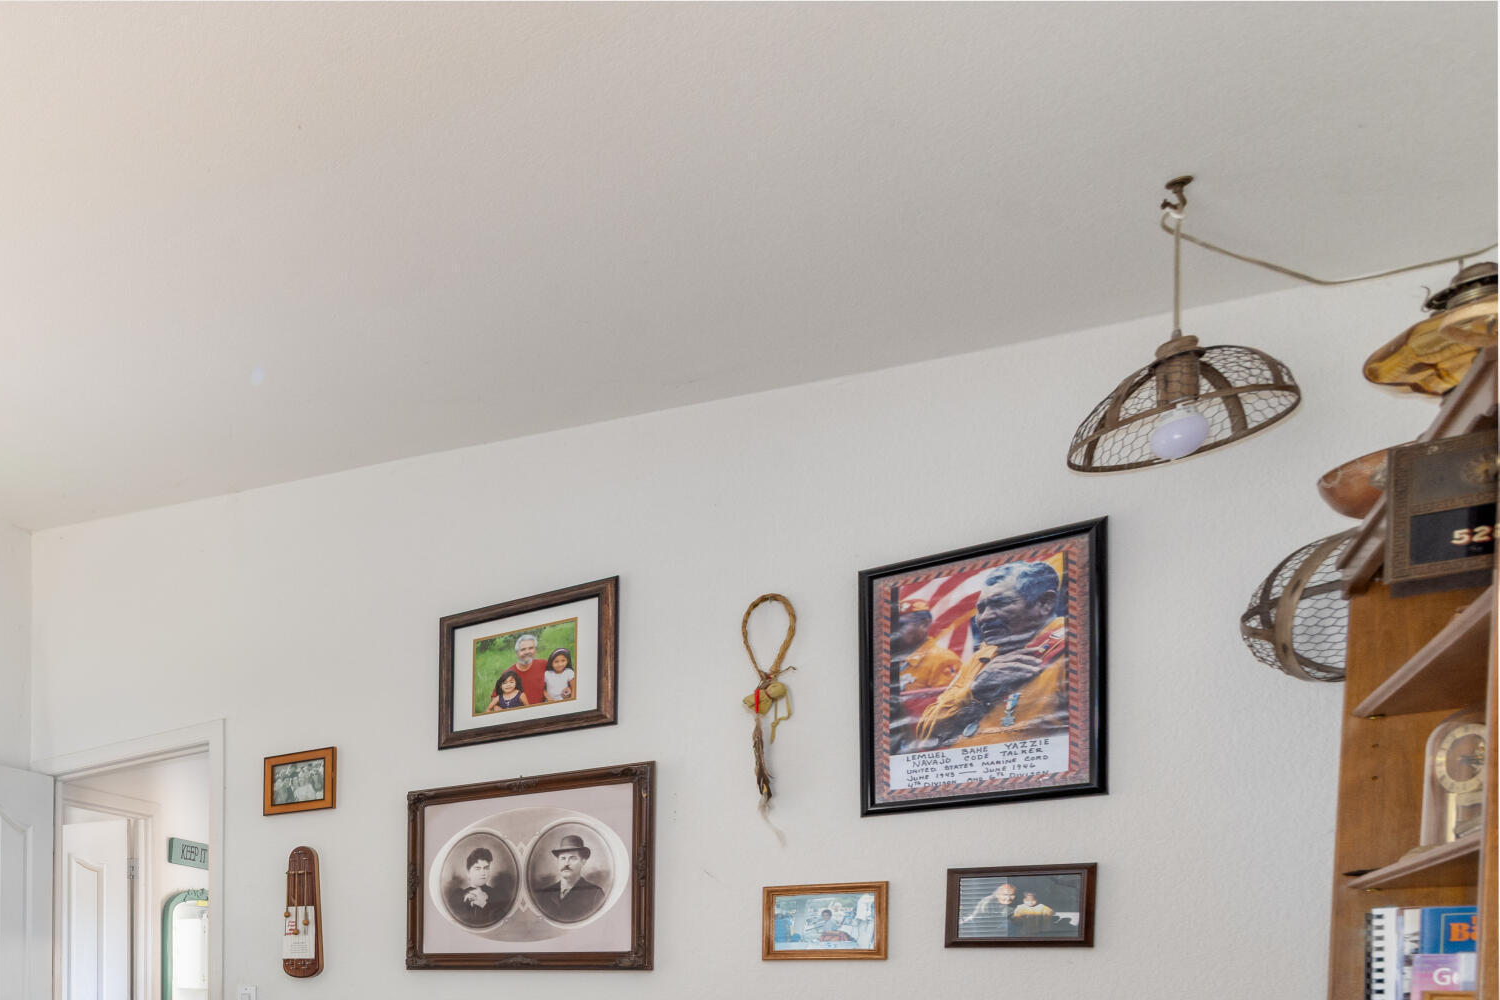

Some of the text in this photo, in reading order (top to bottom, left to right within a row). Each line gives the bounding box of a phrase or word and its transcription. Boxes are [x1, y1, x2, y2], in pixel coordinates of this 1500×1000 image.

[906, 738, 1050, 763] LEMUEL BAHE YAZZIE
[912, 747, 1044, 768] NAVAJO CODE TALKER
[906, 767, 937, 775] UNITED
[944, 762, 974, 771] STATES
[981, 758, 1017, 767] MARINE
[982, 765, 1007, 773] JUNE
[181, 844, 208, 864] KEEP IT
